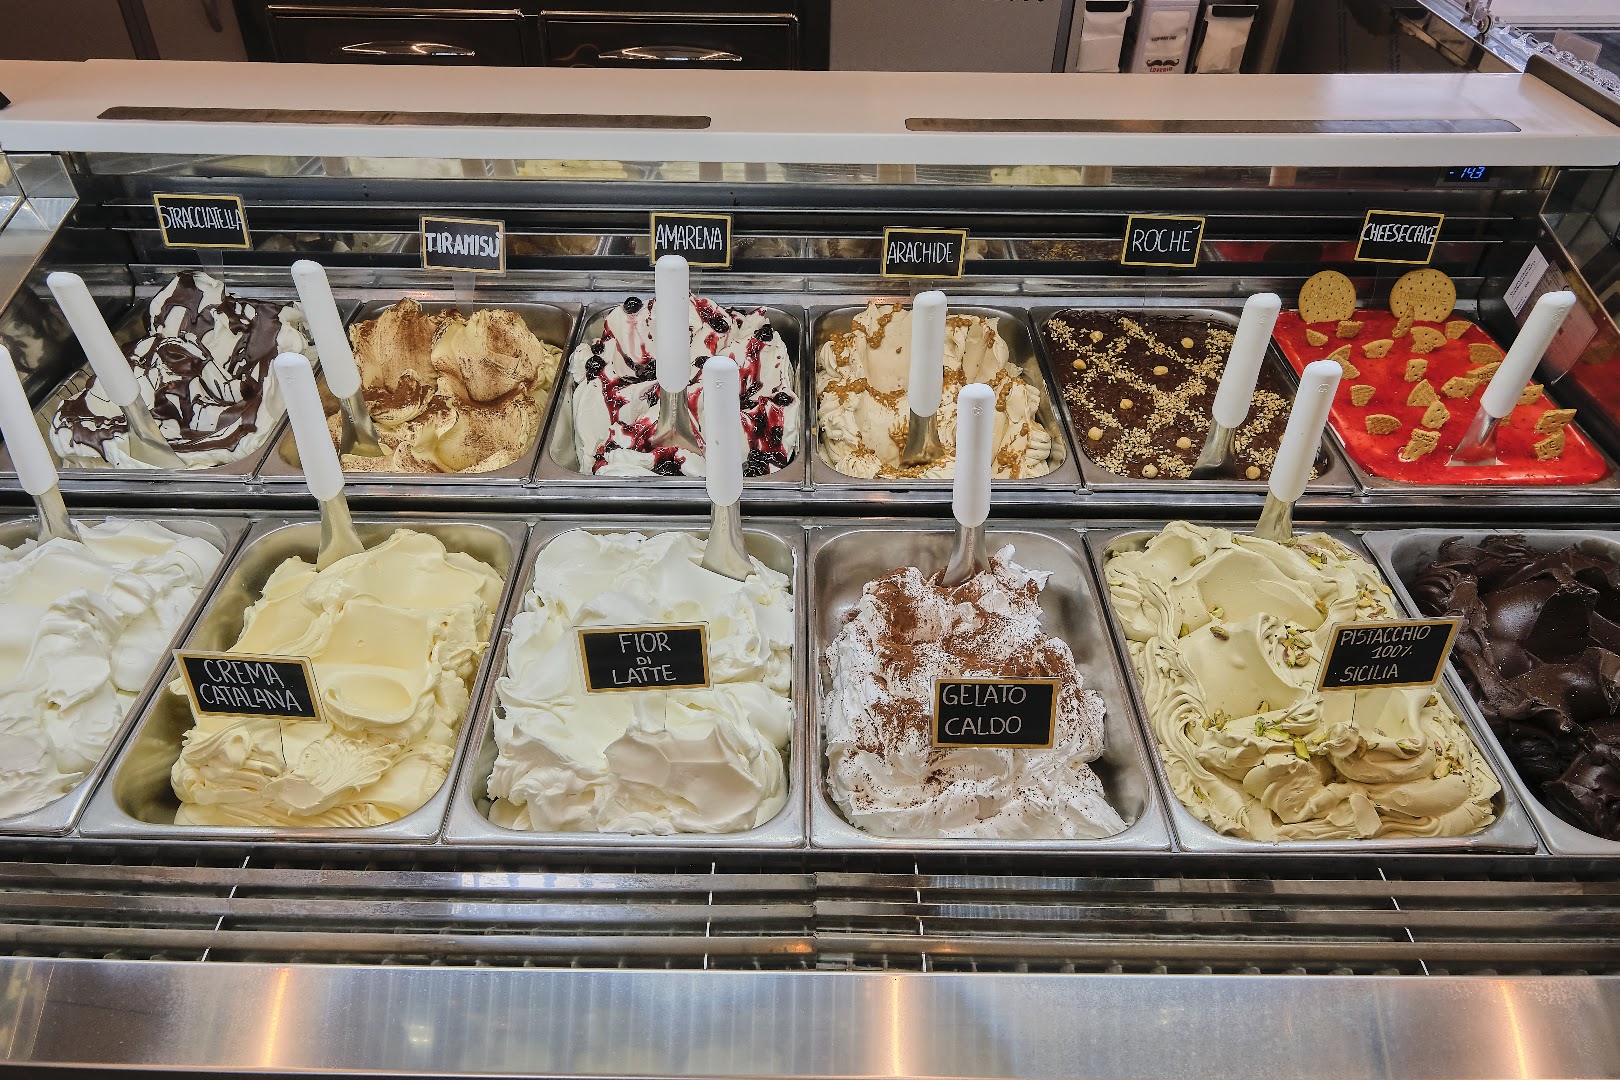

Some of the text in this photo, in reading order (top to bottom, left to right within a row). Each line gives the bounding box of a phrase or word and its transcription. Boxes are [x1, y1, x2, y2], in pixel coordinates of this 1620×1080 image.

[159, 205, 245, 230] STRACCIATELLA
[425, 231, 503, 258] TIRAMISÙ
[655, 223, 723, 250] AMARENA
[1132, 224, 1201, 253] ROCHÉ
[1361, 222, 1438, 245] CHEESECAKE
[886, 240, 954, 264] ARACHIDE
[618, 631, 672, 653] FIOR
[1340, 625, 1431, 646] PISTACCHIO
[635, 656, 652, 665] DI
[1371, 644, 1414, 659] 100%
[203, 659, 285, 689] CREMA
[611, 664, 677, 685] LATTE
[1340, 663, 1399, 682] SICILIA
[199, 683, 303, 712] CATALANA
[942, 684, 1027, 707] GELATO
[944, 715, 1022, 736] CALDO
